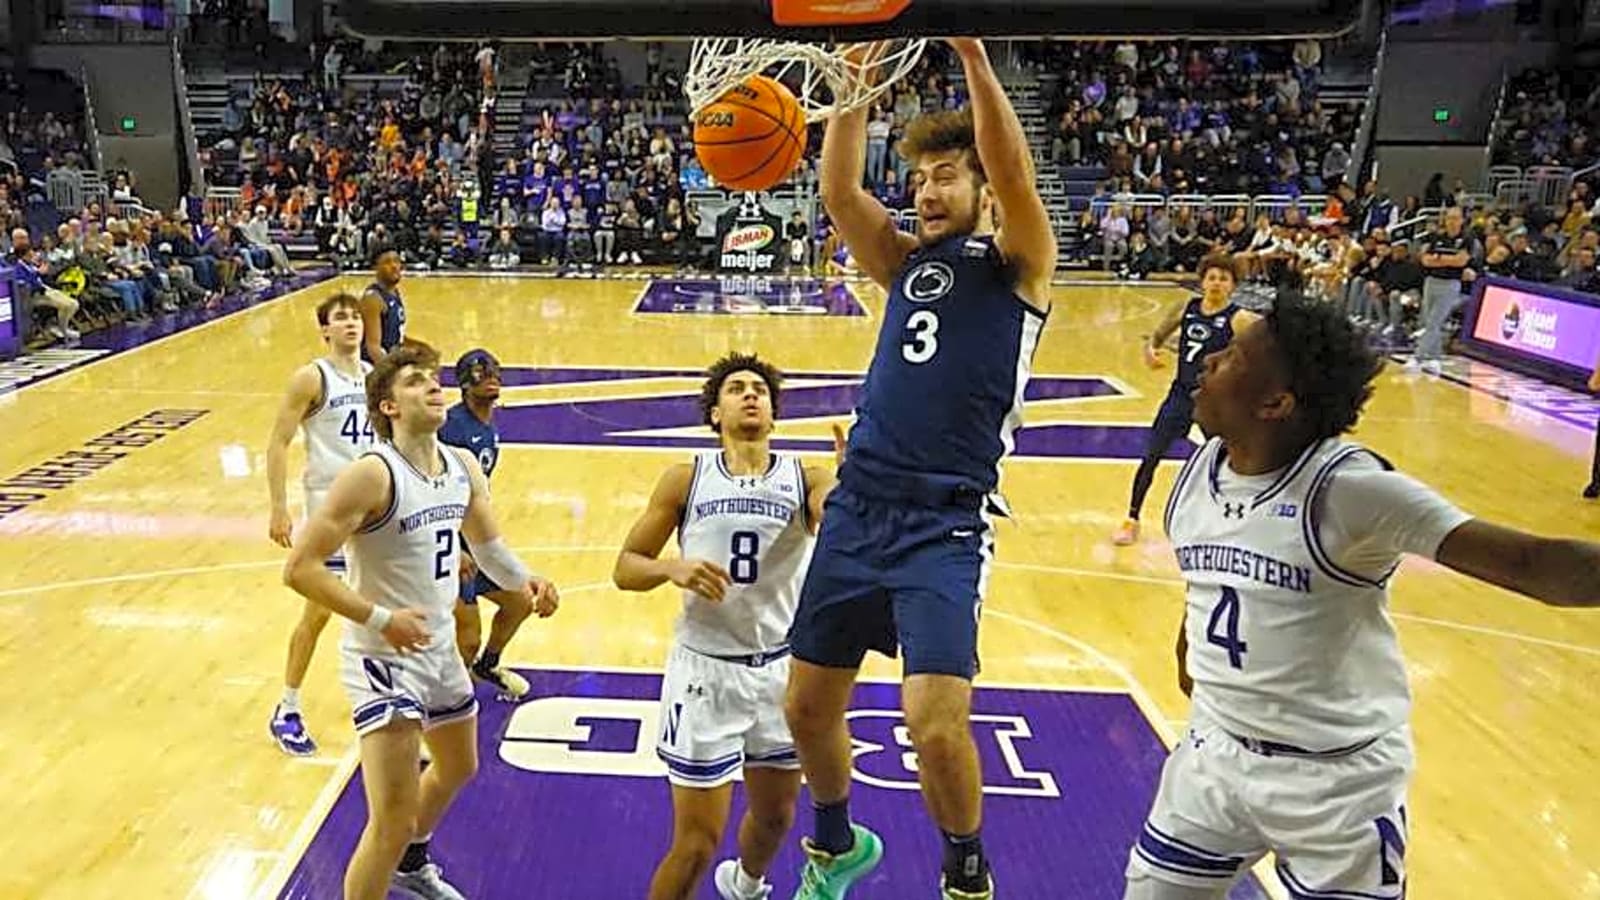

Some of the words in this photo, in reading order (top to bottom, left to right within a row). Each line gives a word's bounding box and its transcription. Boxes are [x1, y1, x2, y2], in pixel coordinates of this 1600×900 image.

[721, 251, 775, 272] meijer
[902, 310, 939, 363] 3
[1186, 341, 1203, 362] 7
[341, 409, 374, 444] 44
[435, 528, 453, 580] 2
[730, 531, 759, 583] 8
[1206, 584, 1248, 669] 4
